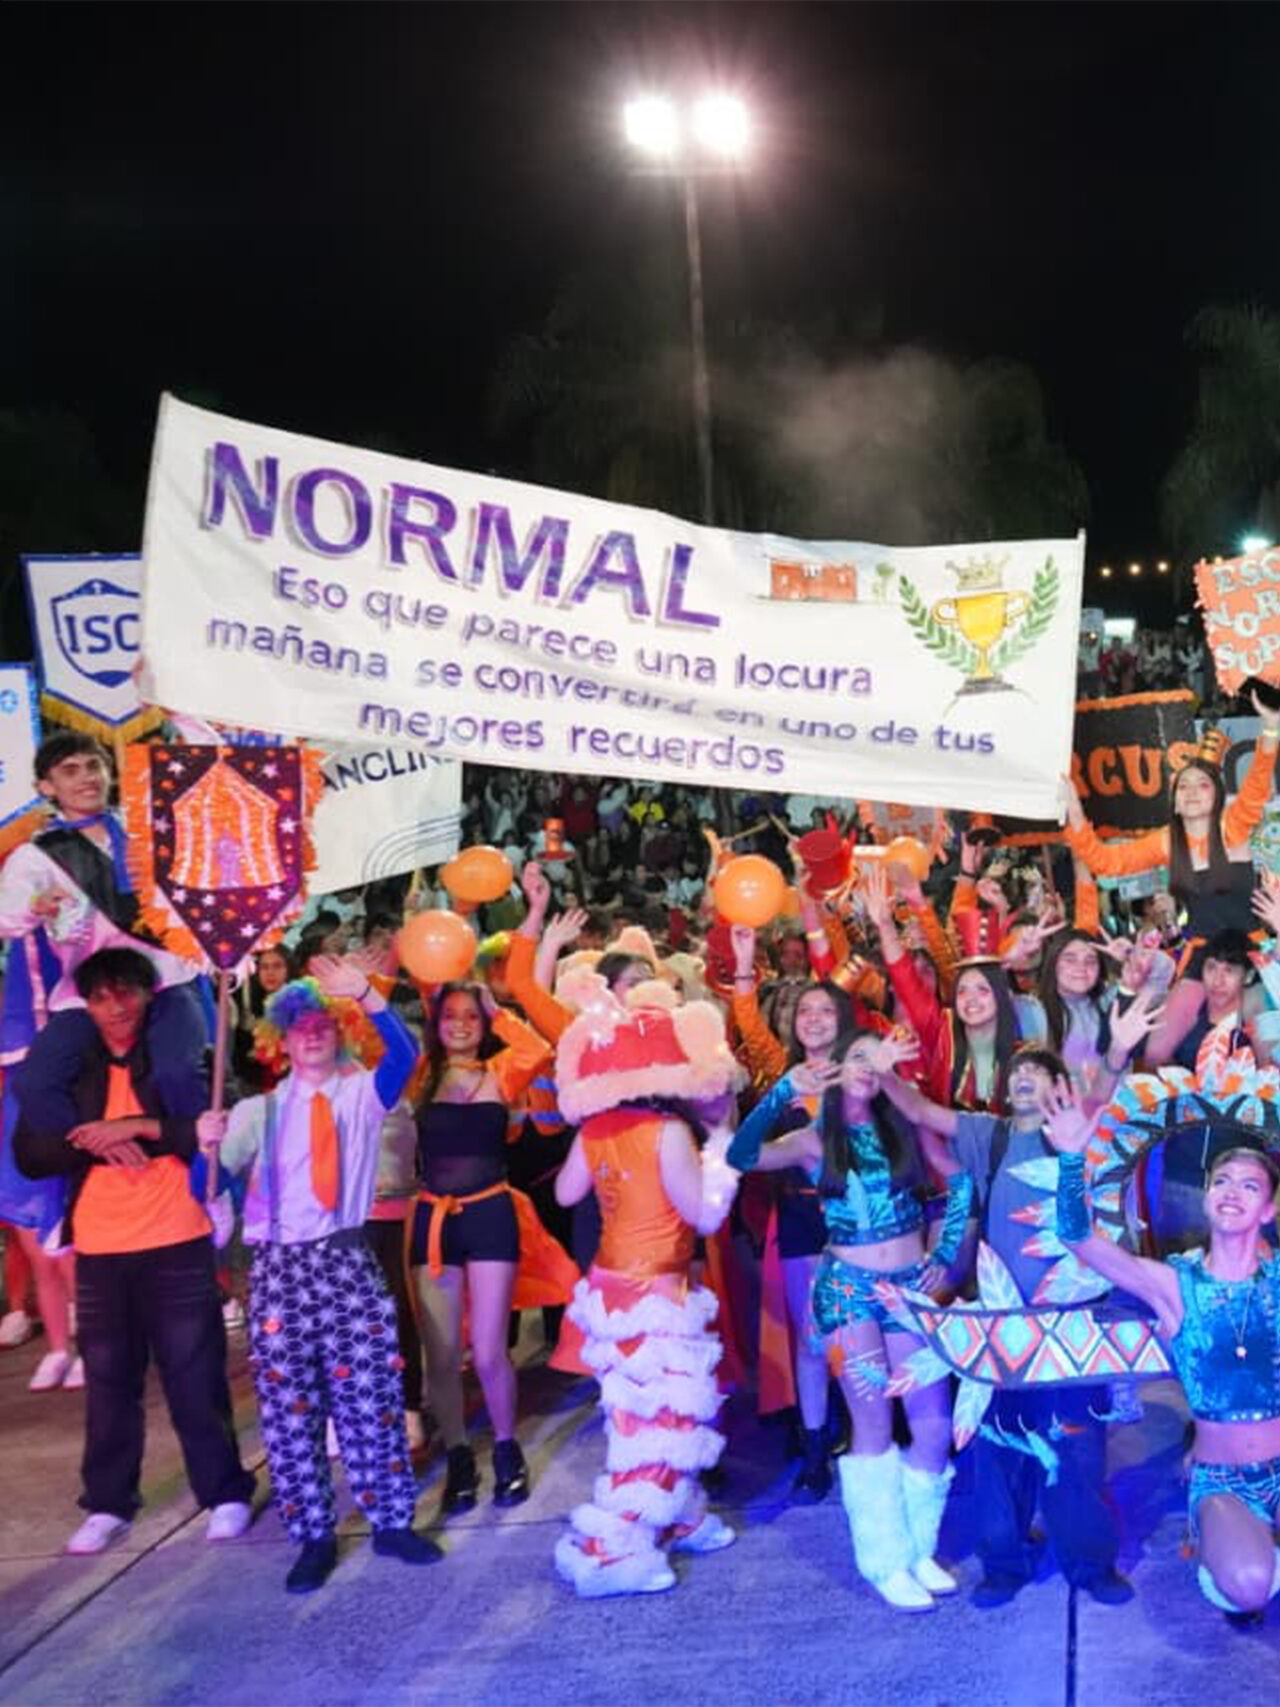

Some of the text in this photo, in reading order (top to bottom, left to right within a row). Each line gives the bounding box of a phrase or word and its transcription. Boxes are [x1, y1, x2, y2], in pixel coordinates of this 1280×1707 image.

[202, 441, 722, 632] NORMAL
[64, 613, 140, 654] ISC
[208, 618, 388, 680] mañana
[417, 658, 463, 688] se
[714, 705, 764, 728] en
[781, 715, 856, 743] uno
[871, 720, 919, 746] de
[933, 725, 996, 755] tus
[275, 567, 872, 695] Eso que parece una locura
[360, 703, 786, 775] mejores recuerdos
